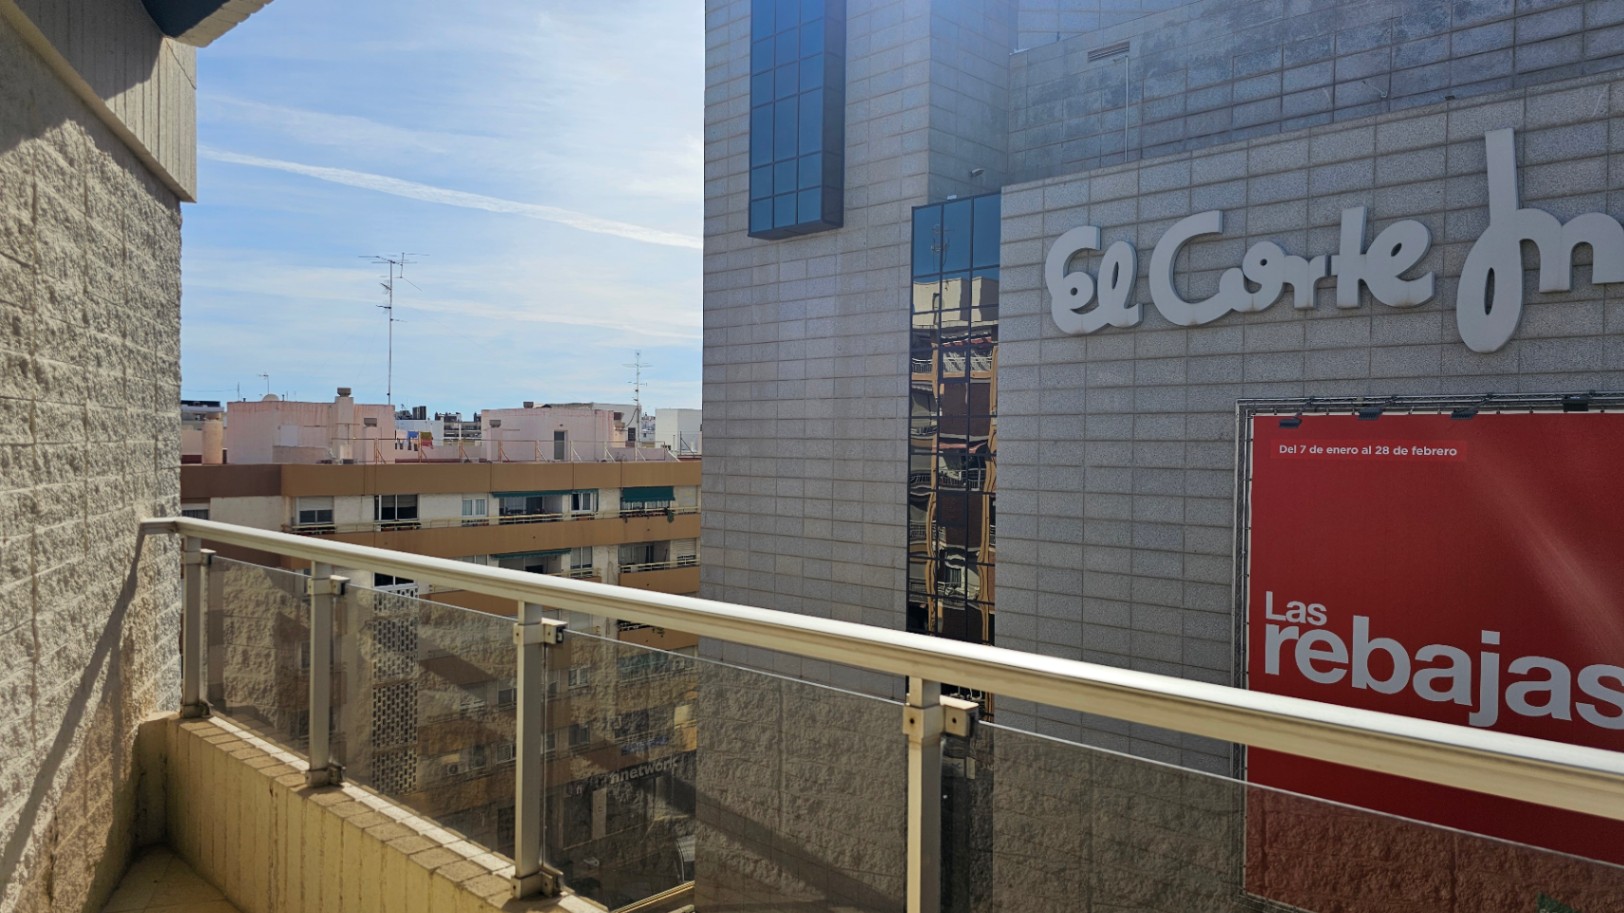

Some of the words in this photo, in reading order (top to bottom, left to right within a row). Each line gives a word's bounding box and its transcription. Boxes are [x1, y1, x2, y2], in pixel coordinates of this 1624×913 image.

[1045, 225, 1143, 335] El
[1149, 206, 1436, 327] Corte
[1279, 444, 1297, 454] Del
[1300, 444, 1307, 454] 7
[1309, 444, 1324, 454] de
[1326, 446, 1359, 455] enero
[1361, 445, 1372, 455] al
[1375, 446, 1390, 455] 28
[1393, 446, 1409, 456] de
[1411, 446, 1458, 456] febrero
[1265, 590, 1328, 626] Las
[1264, 614, 1624, 729] rebajas
